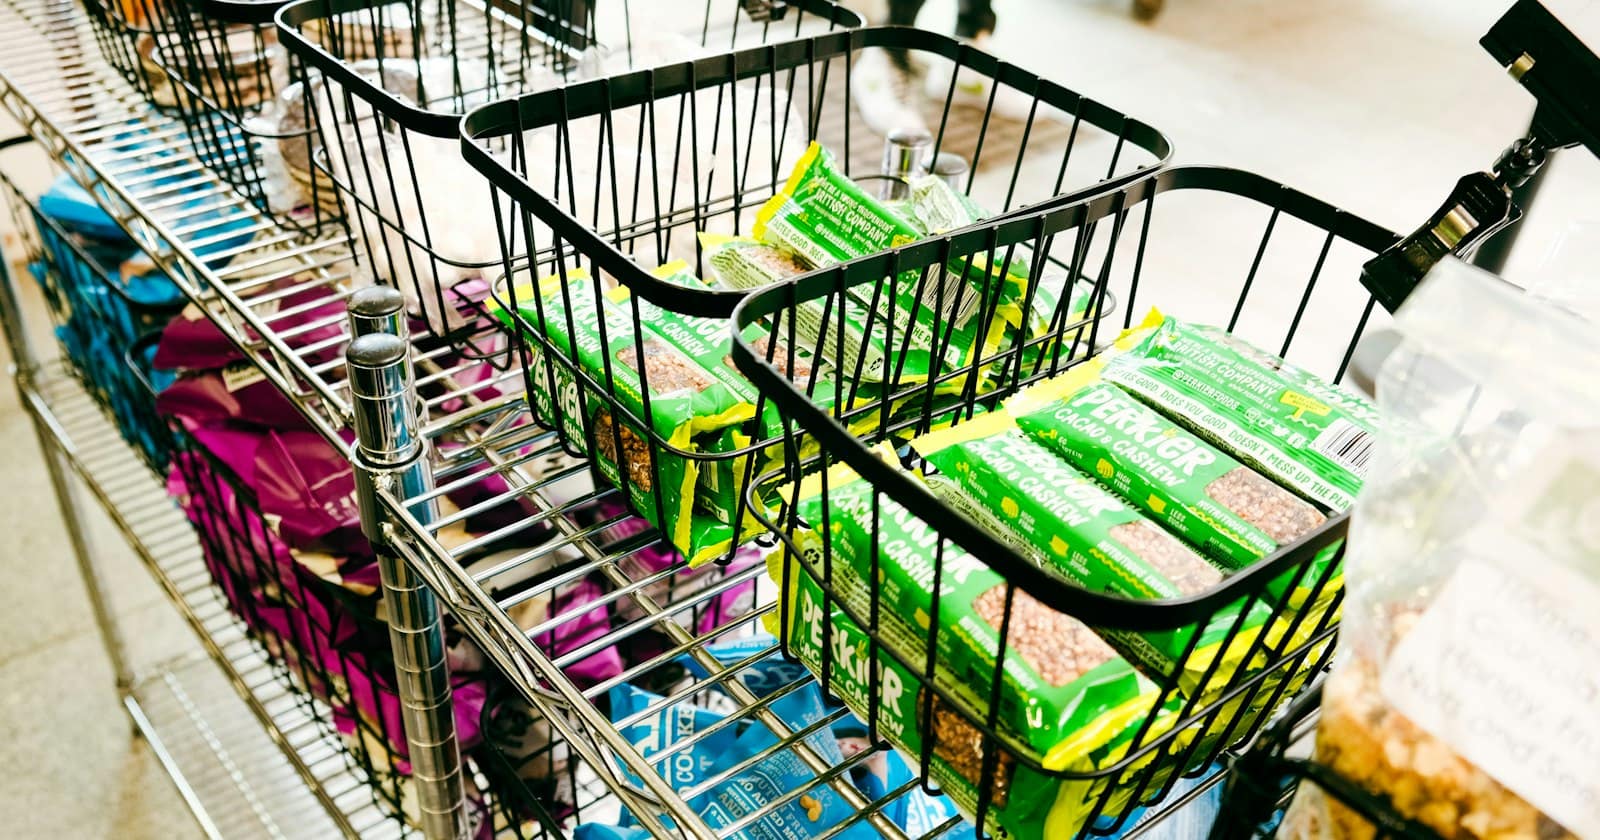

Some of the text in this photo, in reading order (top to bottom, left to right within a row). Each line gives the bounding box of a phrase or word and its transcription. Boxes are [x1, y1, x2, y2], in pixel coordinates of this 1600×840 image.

[879, 300, 901, 321] MES
[662, 321, 711, 357] CASHEW
[1171, 340, 1218, 372] BRITISH
[1054, 407, 1108, 438] CACAO
[1112, 440, 1187, 488] CASHEW
[1071, 388, 1216, 477] PERKIER
[1184, 400, 1203, 417] YOU
[1227, 428, 1268, 456] DOESN'T
[1266, 452, 1298, 476] MESS
[1294, 470, 1312, 485] UP
[1310, 480, 1331, 498] THE
[1327, 491, 1351, 511] PLA
[963, 440, 1017, 475] CACAO
[1018, 474, 1091, 528] CASHEW
[1115, 471, 1132, 485] HIGH
[1169, 508, 1187, 523] LESS
[1196, 500, 1277, 554] NUTRITIOUS ENERG
[844, 679, 905, 738] CASEW
[719, 792, 745, 818] AND
[751, 791, 785, 827] ADED
